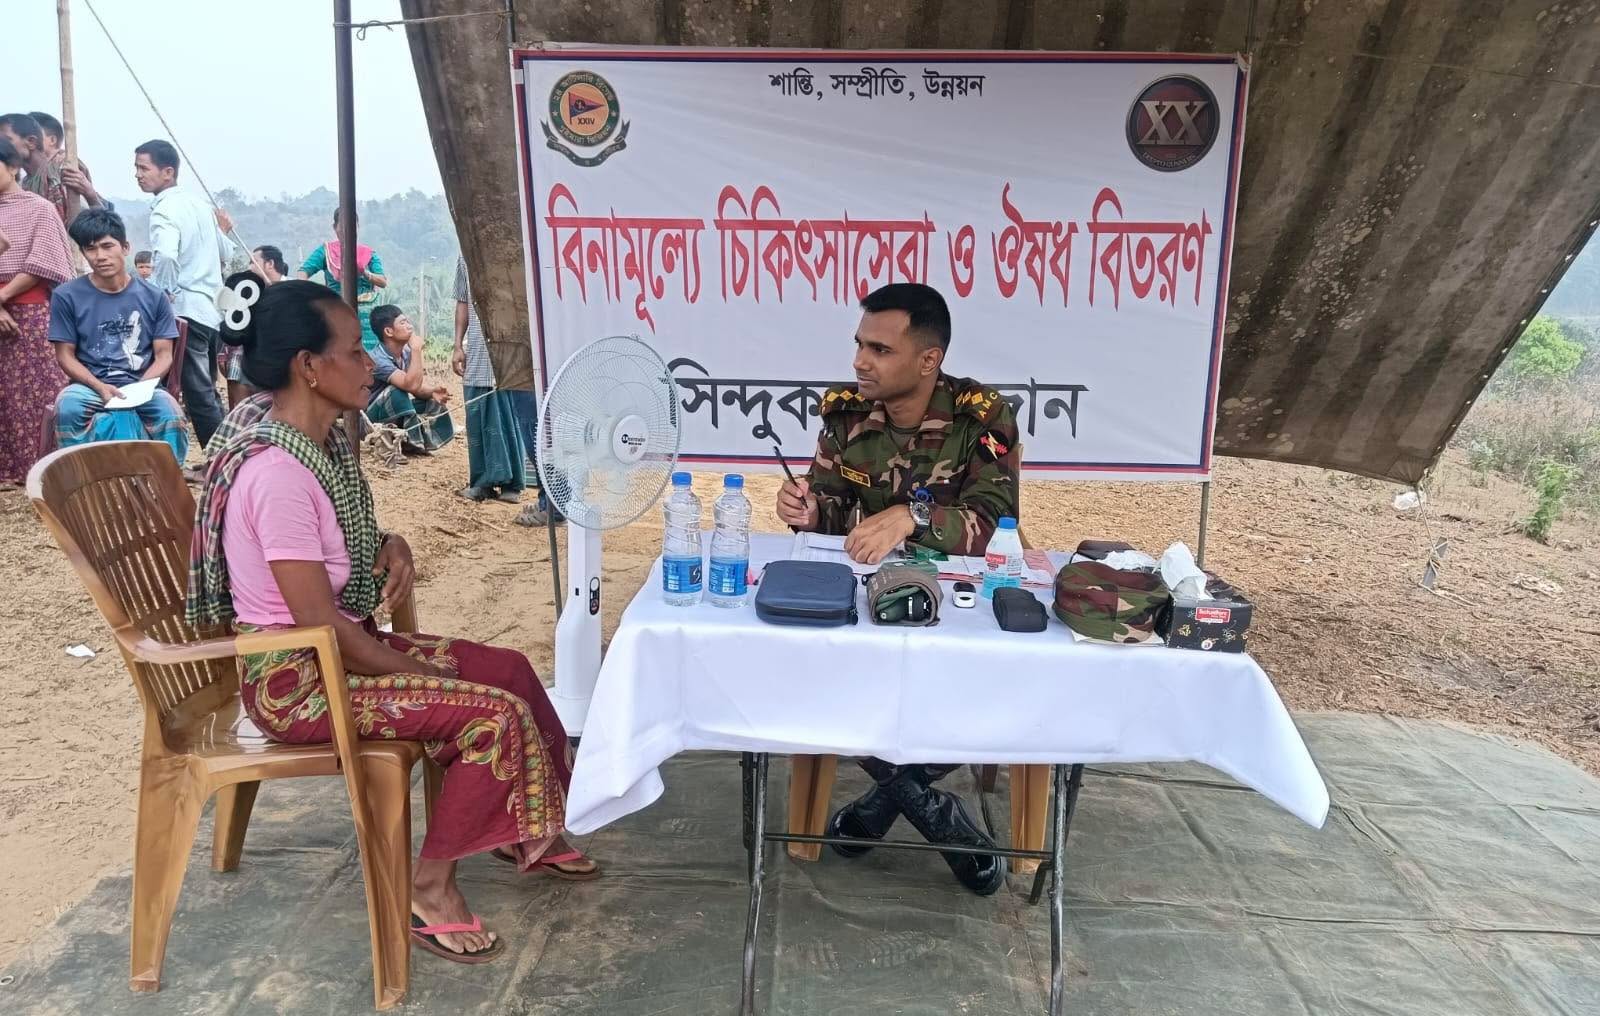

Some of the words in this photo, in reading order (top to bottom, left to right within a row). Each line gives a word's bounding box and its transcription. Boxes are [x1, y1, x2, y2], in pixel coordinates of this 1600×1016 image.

[768, 67, 823, 101] শান্তি,
[922, 68, 986, 100] উন্নয়ন
[577, 117, 595, 126] XXIV
[1136, 100, 1209, 145] XX
[544, 183, 706, 331] বিনামূল্যে
[713, 185, 937, 305] চিকিৎসাসেবা
[947, 224, 976, 298] ও
[991, 181, 1079, 308] ঔষধ
[1086, 187, 1213, 312] বিতরণ
